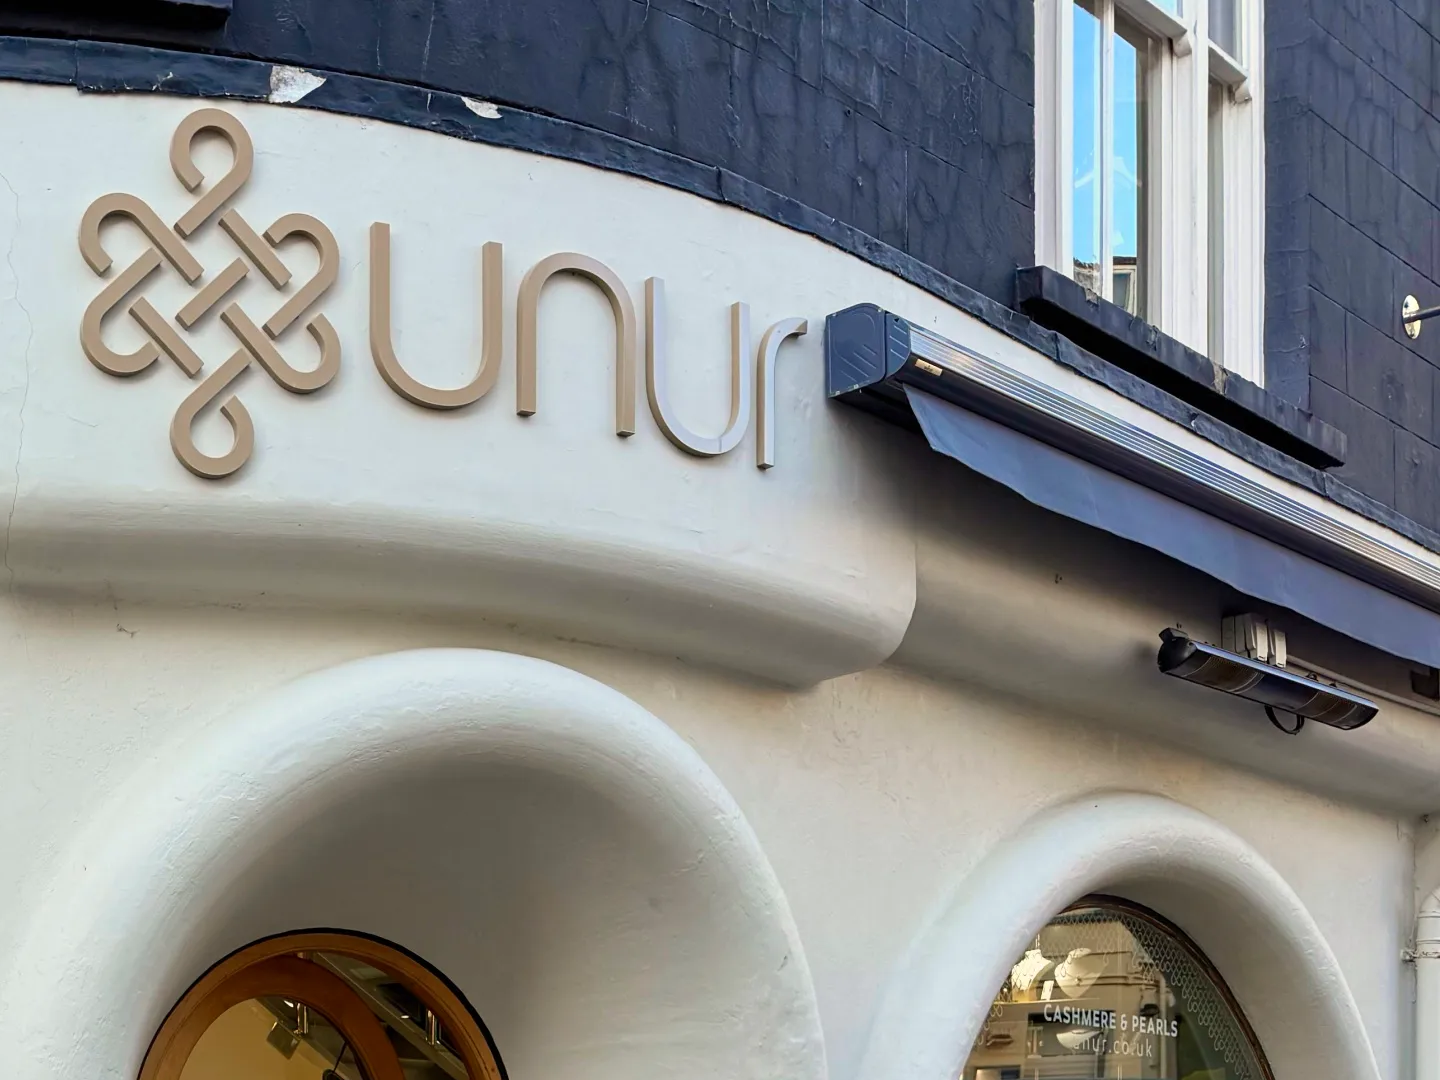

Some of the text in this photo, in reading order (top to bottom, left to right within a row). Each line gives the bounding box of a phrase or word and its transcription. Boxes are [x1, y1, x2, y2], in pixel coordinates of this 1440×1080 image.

[369, 221, 808, 469] unur
[1043, 1003, 1178, 1037] CASHMERE & PEARLS
